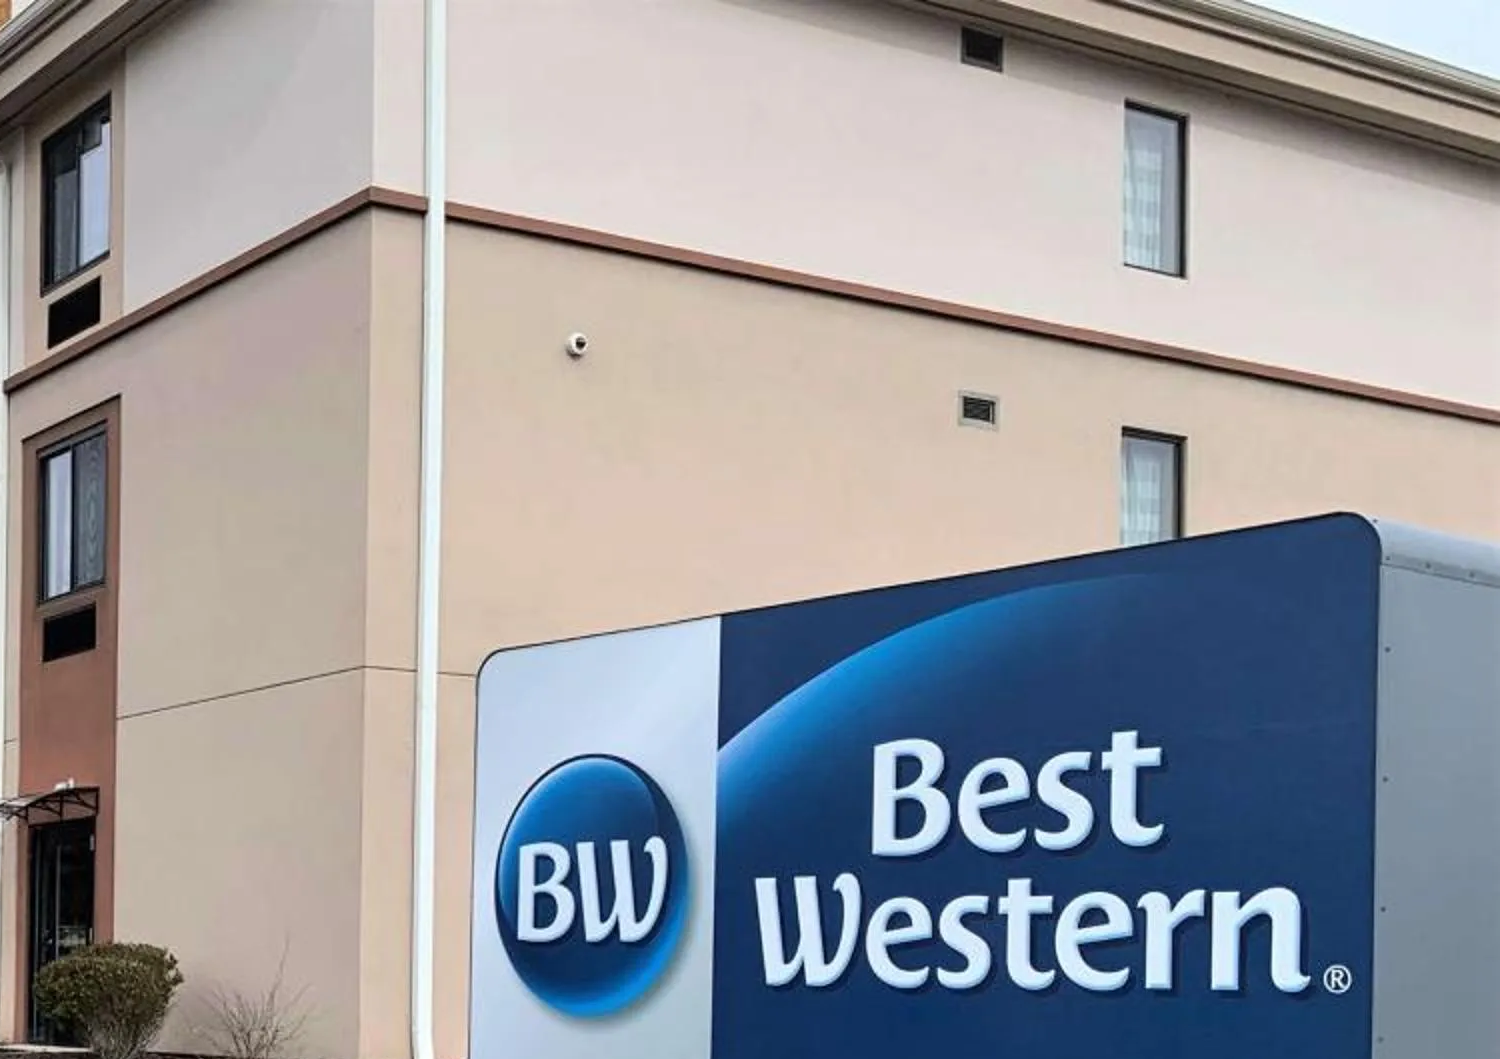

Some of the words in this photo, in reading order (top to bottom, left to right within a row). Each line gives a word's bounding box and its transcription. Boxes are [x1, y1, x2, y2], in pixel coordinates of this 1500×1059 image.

[871, 730, 1164, 857] Best
[516, 836, 667, 943] BW
[755, 872, 1312, 993] Western
